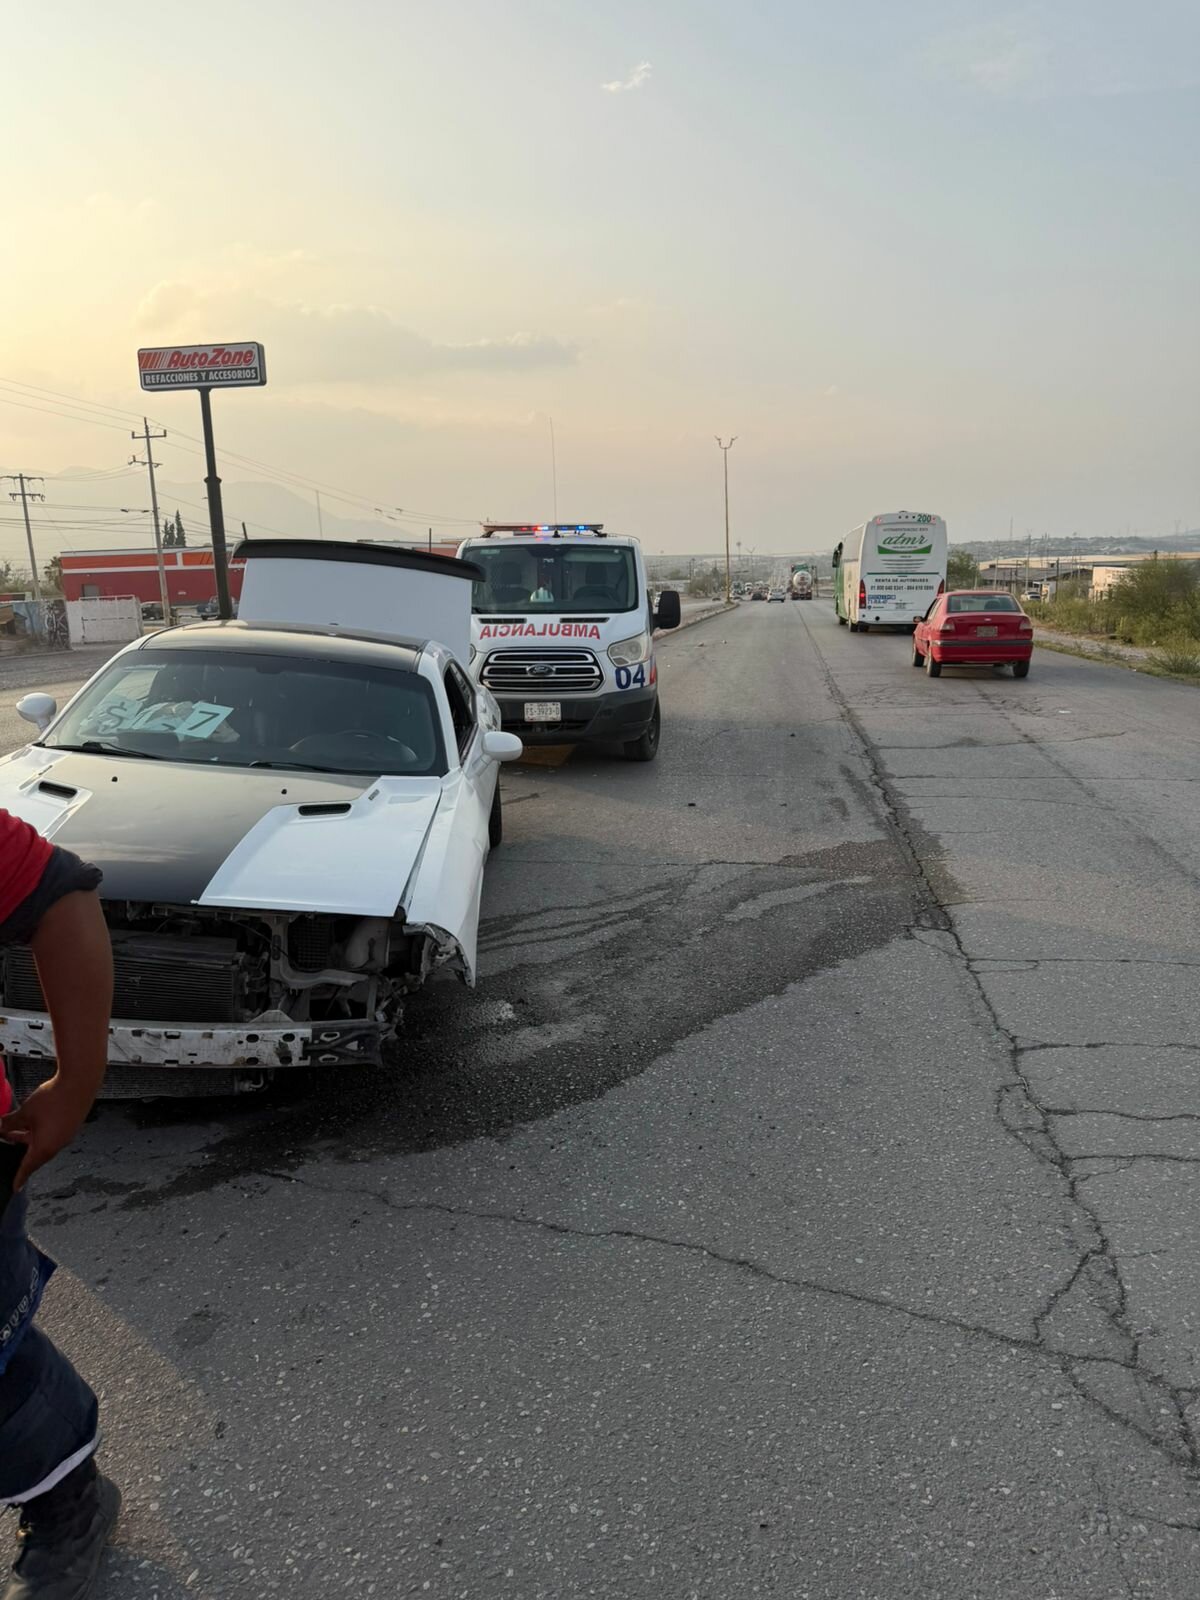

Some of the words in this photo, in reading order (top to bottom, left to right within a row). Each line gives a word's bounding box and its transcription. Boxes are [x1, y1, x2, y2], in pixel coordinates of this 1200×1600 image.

[168, 347, 254, 368] AutoZone
[145, 373, 198, 384] REFACCIONES
[200, 372, 206, 380] Y
[209, 369, 256, 380] ACCESORIOS
[917, 514, 931, 523] 200
[615, 663, 645, 690] 04
